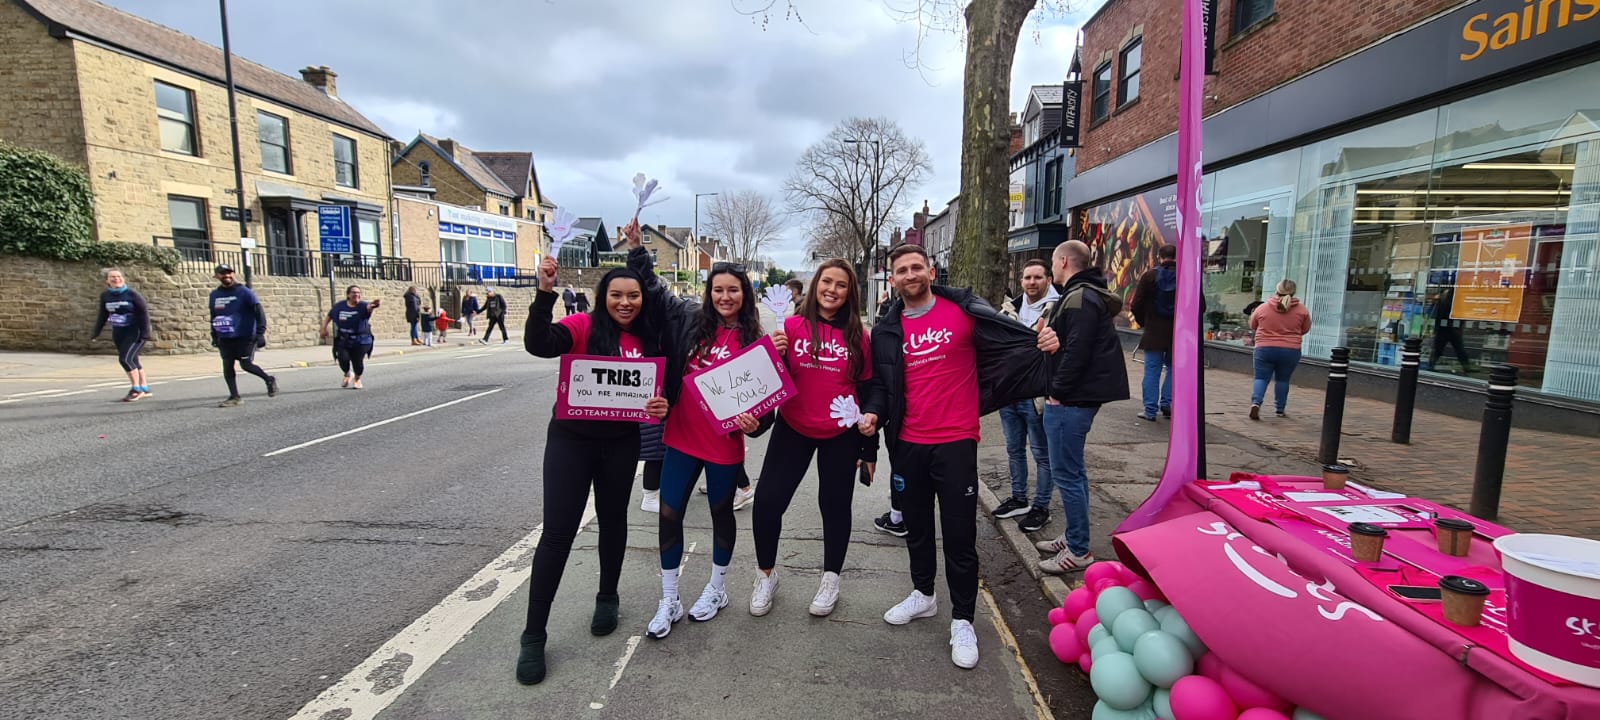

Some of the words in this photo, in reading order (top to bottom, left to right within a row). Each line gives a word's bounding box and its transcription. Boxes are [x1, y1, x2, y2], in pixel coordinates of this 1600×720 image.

[910, 327, 952, 349] Luke's
[573, 374, 584, 383] GO
[591, 368, 641, 387] TRIB3
[642, 377, 654, 387] GO
[576, 389, 592, 397] YOU
[753, 406, 765, 416] ST
[762, 389, 788, 410] LUKE'S
[567, 408, 582, 416] GO
[584, 409, 608, 417] TEAM
[622, 411, 651, 420] LUKE'S
